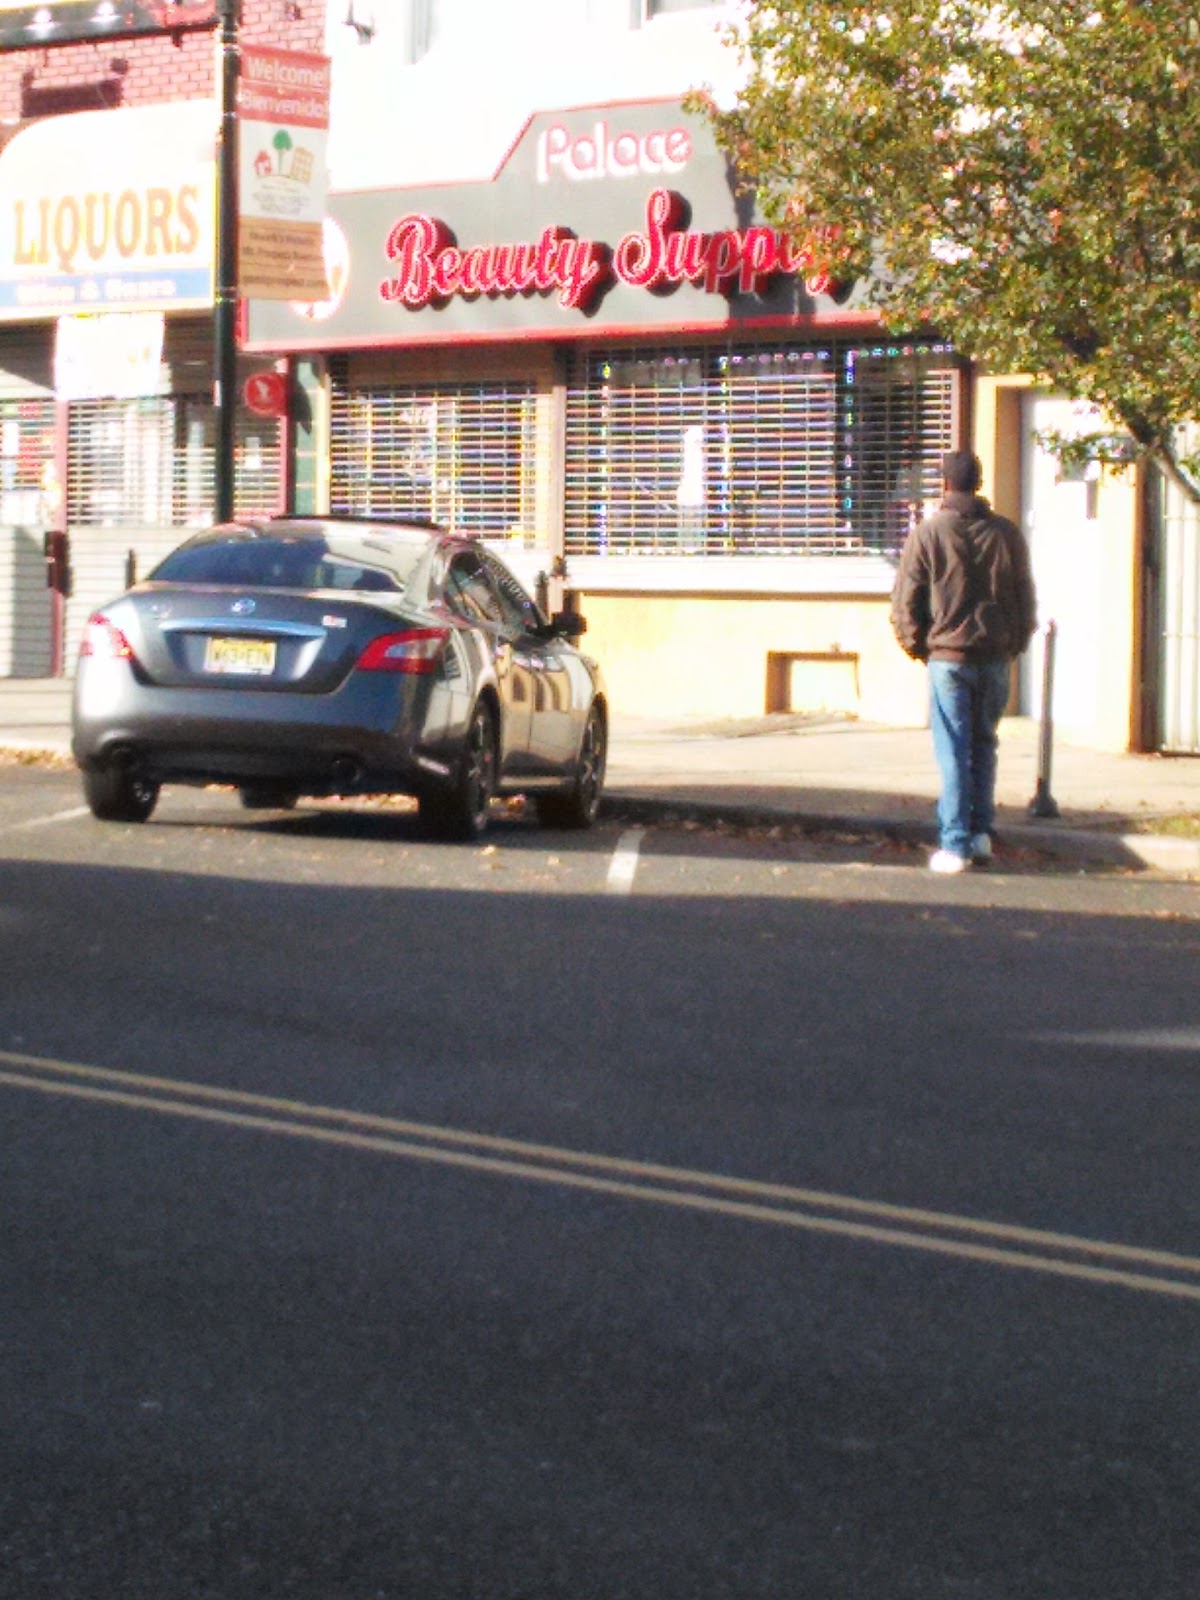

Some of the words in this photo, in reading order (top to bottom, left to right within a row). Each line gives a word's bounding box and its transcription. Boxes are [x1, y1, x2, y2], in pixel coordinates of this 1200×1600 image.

[247, 56, 323, 86] Welcome
[536, 122, 692, 183] Palace
[13, 184, 199, 273] LIQUORS
[380, 213, 598, 309] Beauty
